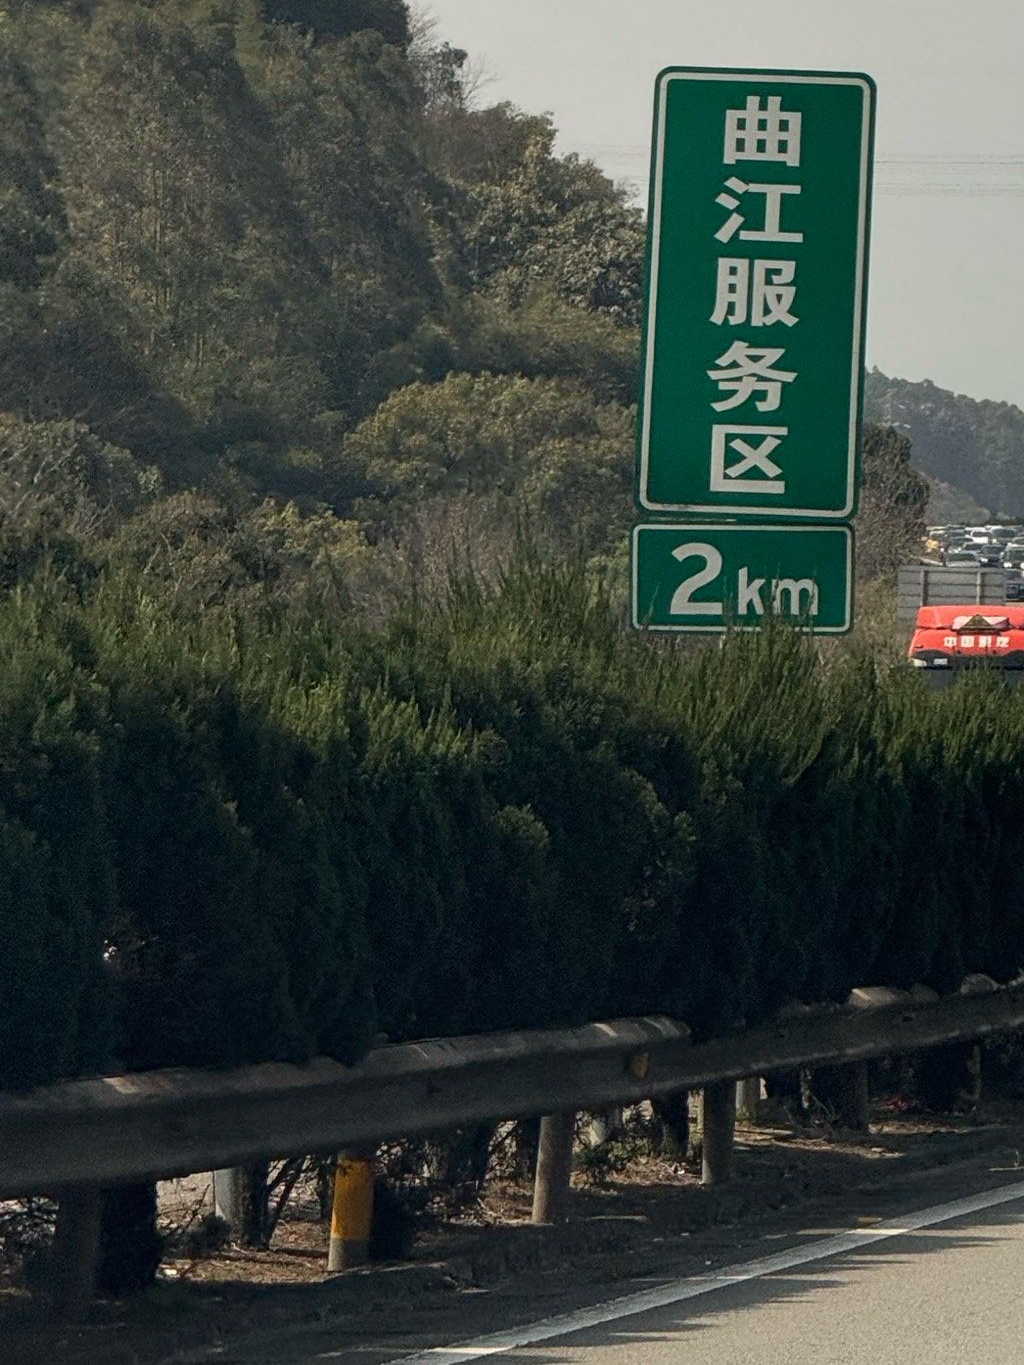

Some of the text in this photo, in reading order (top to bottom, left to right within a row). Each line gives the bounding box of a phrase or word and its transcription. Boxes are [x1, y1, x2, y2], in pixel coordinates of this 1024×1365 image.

[707, 96, 804, 495] 曲江服务区
[669, 542, 819, 616] 2 km
